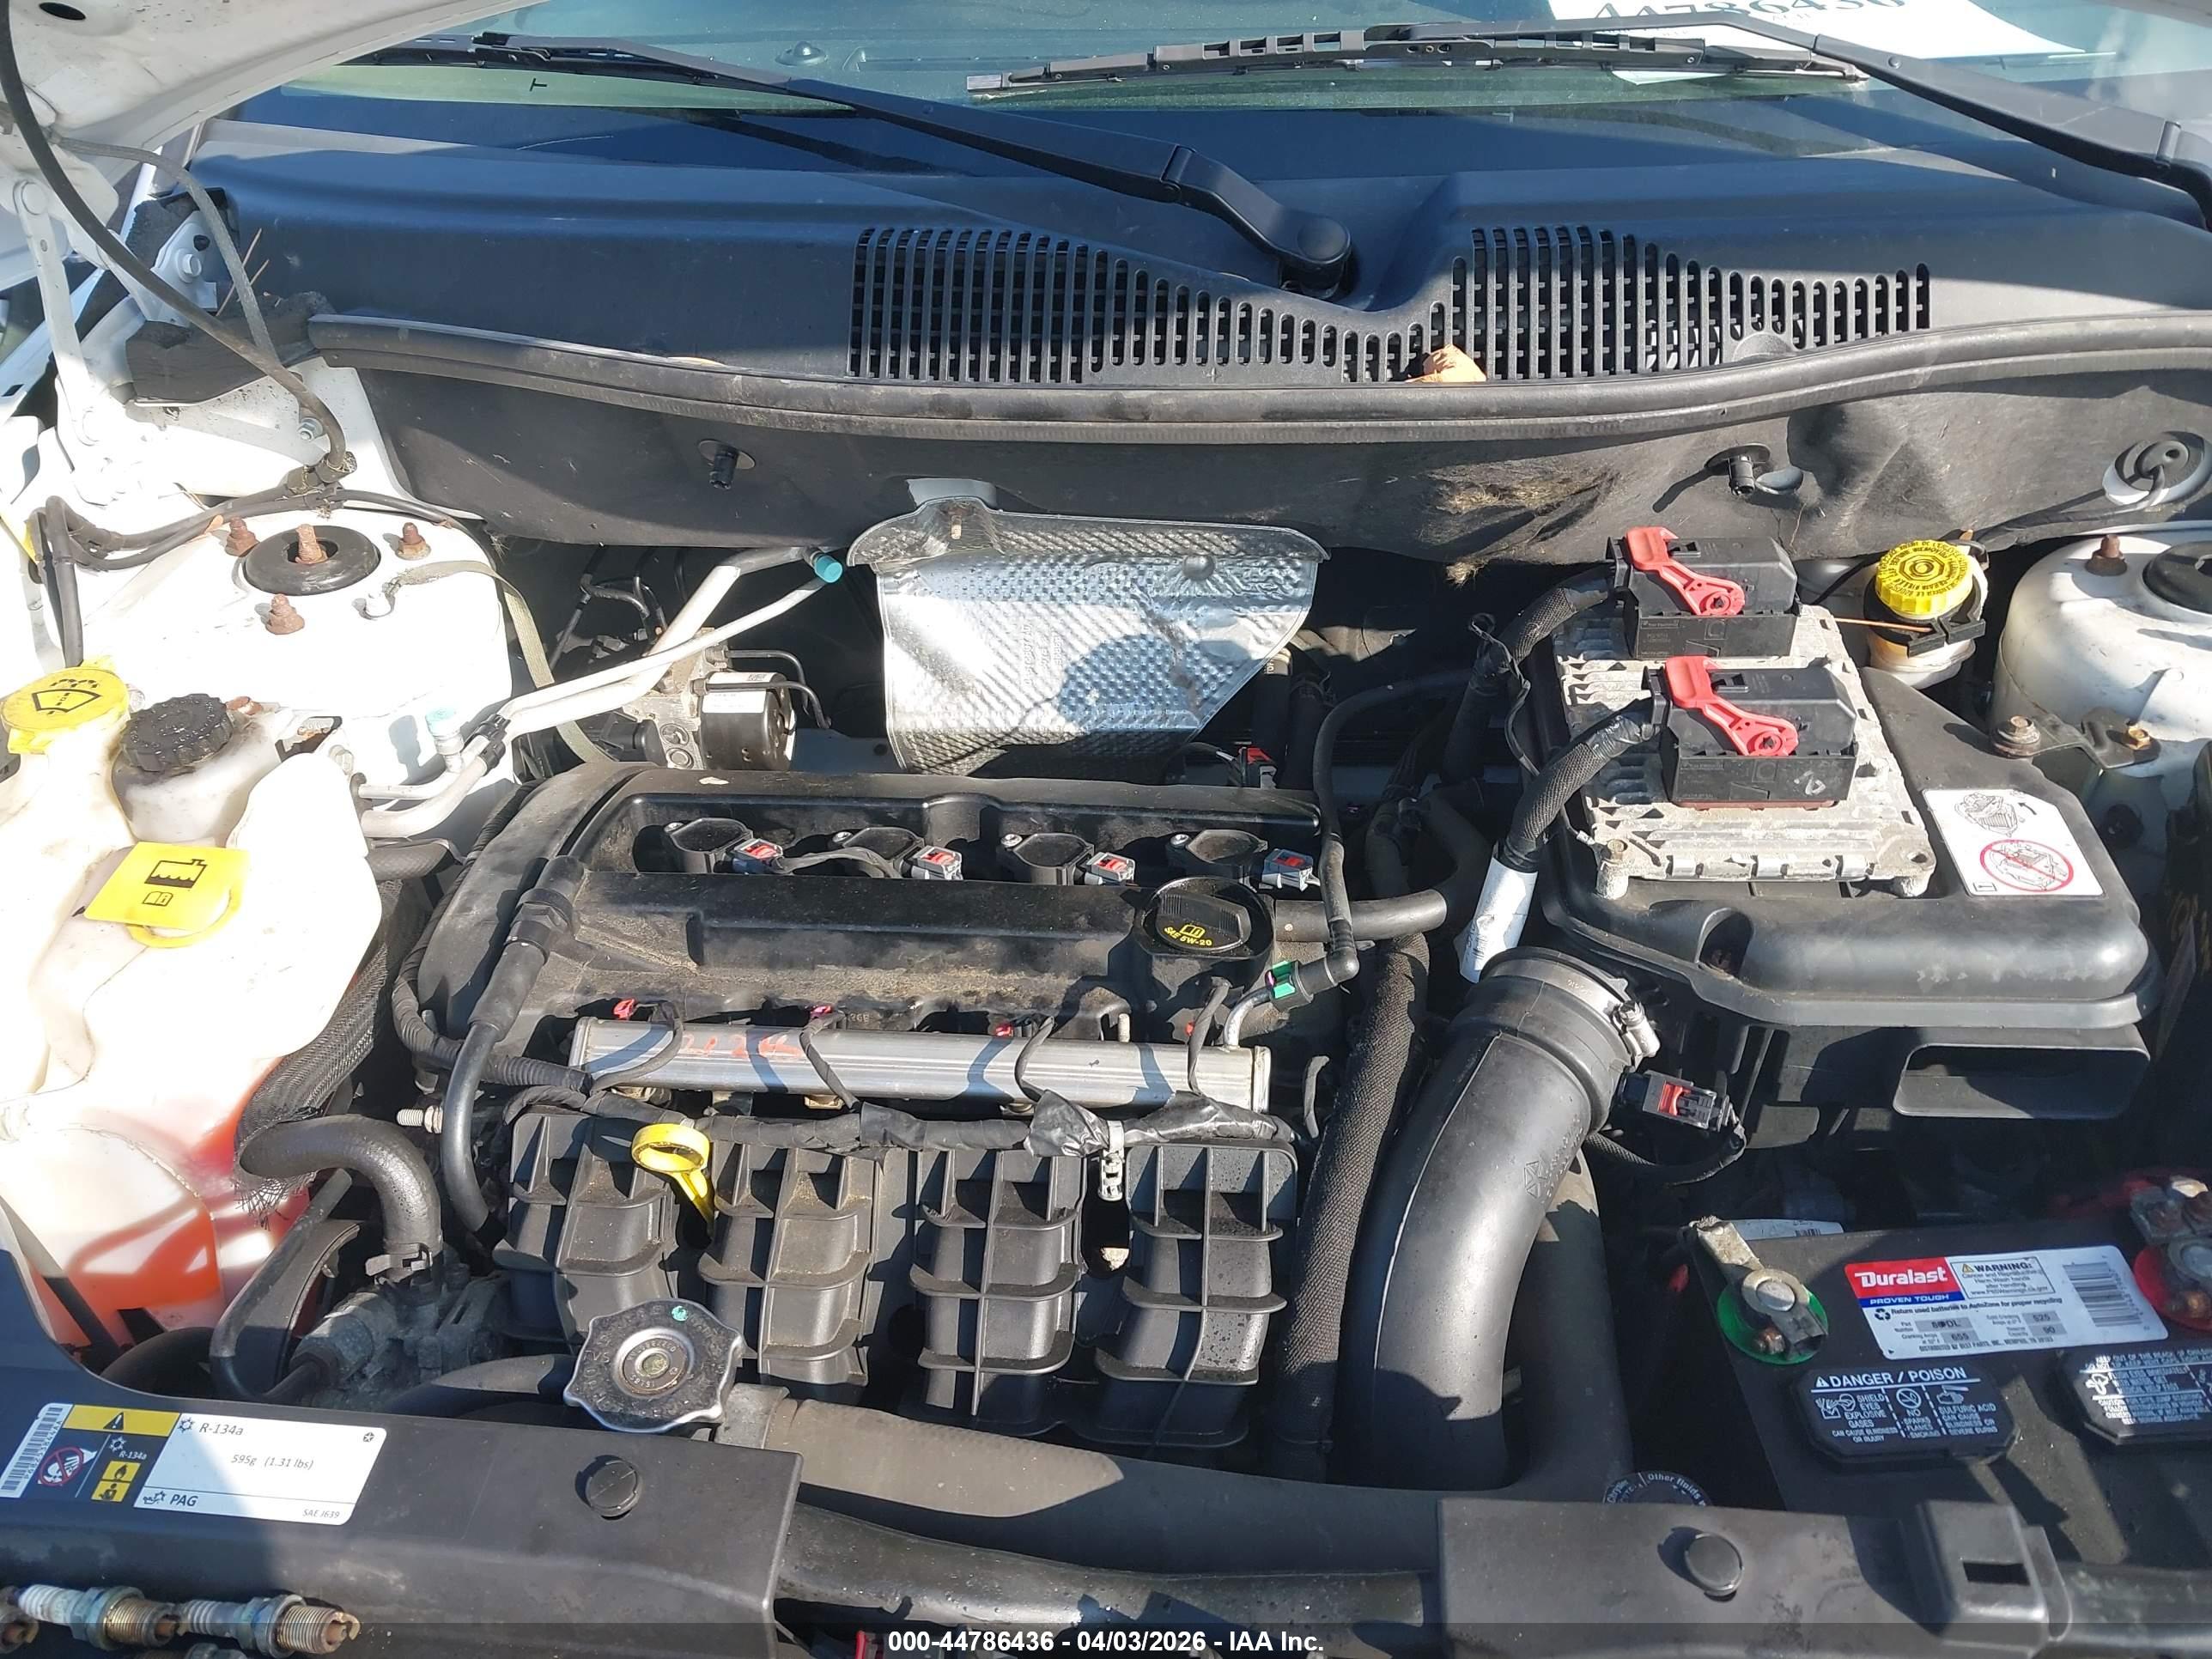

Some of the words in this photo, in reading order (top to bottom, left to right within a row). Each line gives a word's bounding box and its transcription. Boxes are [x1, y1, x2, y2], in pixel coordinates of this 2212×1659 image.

[1164, 927, 1181, 941] SAE
[1180, 936, 1212, 946] 5W-20
[1974, 1261, 2033, 1273] WARNING:
[1855, 1267, 1948, 1287] Duralast
[1870, 1297, 1912, 1305] PROVEN
[1829, 1373, 1893, 1388] DANGER
[1898, 1371, 1904, 1383] /
[1908, 1366, 1967, 1382] POISON
[1856, 1393, 1886, 1403] SHIELD
[1860, 1401, 1881, 1411] EYES
[1938, 1405, 1977, 1415] SULFURIC
[1977, 1402, 1996, 1413] ACID
[1844, 1409, 1887, 1420] EXPLOSIVE
[1906, 1408, 1921, 1417] NO
[1848, 1419, 1875, 1428] GASES
[199, 1424, 244, 1436] R-134a
[118, 1450, 147, 1461] R-134a
[231, 1454, 257, 1467] 595g
[264, 1455, 292, 1468] (1.31
[293, 1458, 313, 1470] lbs)
[1648, 1473, 1674, 1482] Other
[1677, 1478, 1701, 1500] fluids
[169, 1493, 198, 1507] PAG
[302, 1508, 319, 1517] SAE
[320, 1510, 340, 1519] J639
